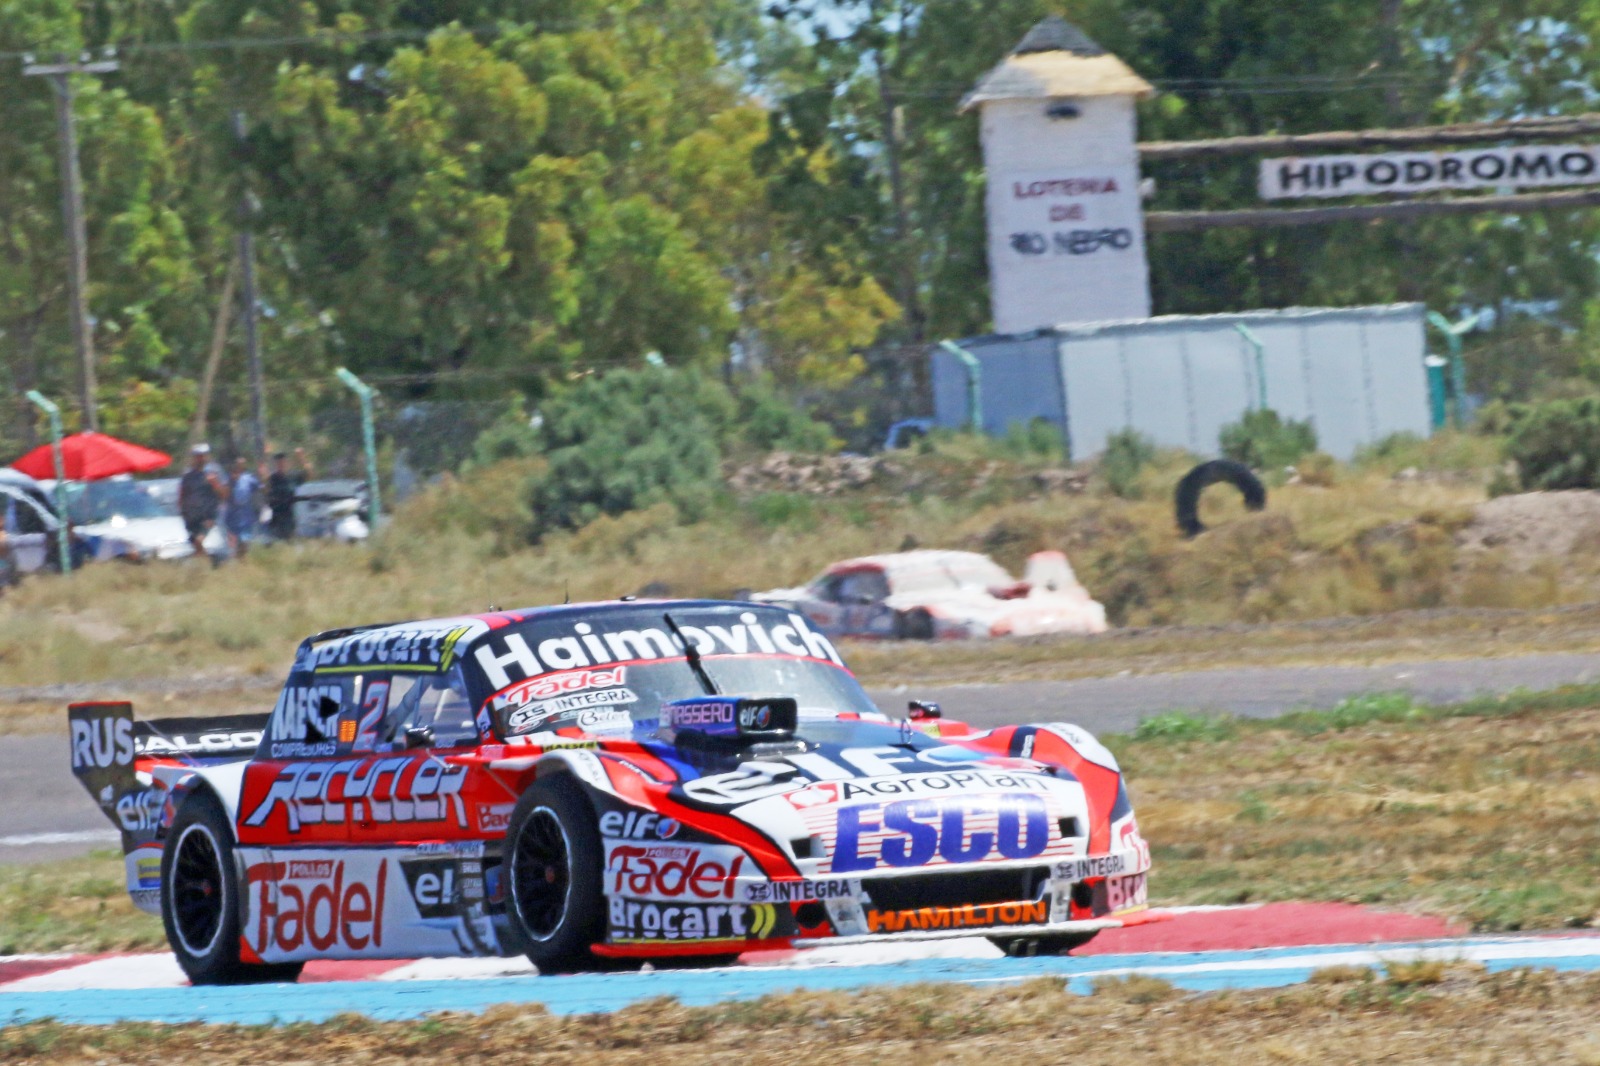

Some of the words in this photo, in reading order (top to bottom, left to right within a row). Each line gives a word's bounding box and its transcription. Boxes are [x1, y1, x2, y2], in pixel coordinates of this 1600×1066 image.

[1279, 152, 1595, 191] HIPODROMO
[475, 612, 844, 691] Haimovich
[507, 668, 626, 704] Fadel
[556, 689, 631, 710] INTEGRA
[352, 680, 391, 752] 2
[71, 716, 133, 768] RUS
[599, 810, 658, 838] elf
[830, 792, 1050, 873] ESCO
[608, 846, 746, 900] Fadel
[1077, 856, 1125, 878] INTEGRA
[246, 858, 387, 954] Fadel
[773, 880, 851, 900] INTEGRA
[609, 899, 747, 938] Brocart
[867, 900, 1046, 932] HAMILTON
